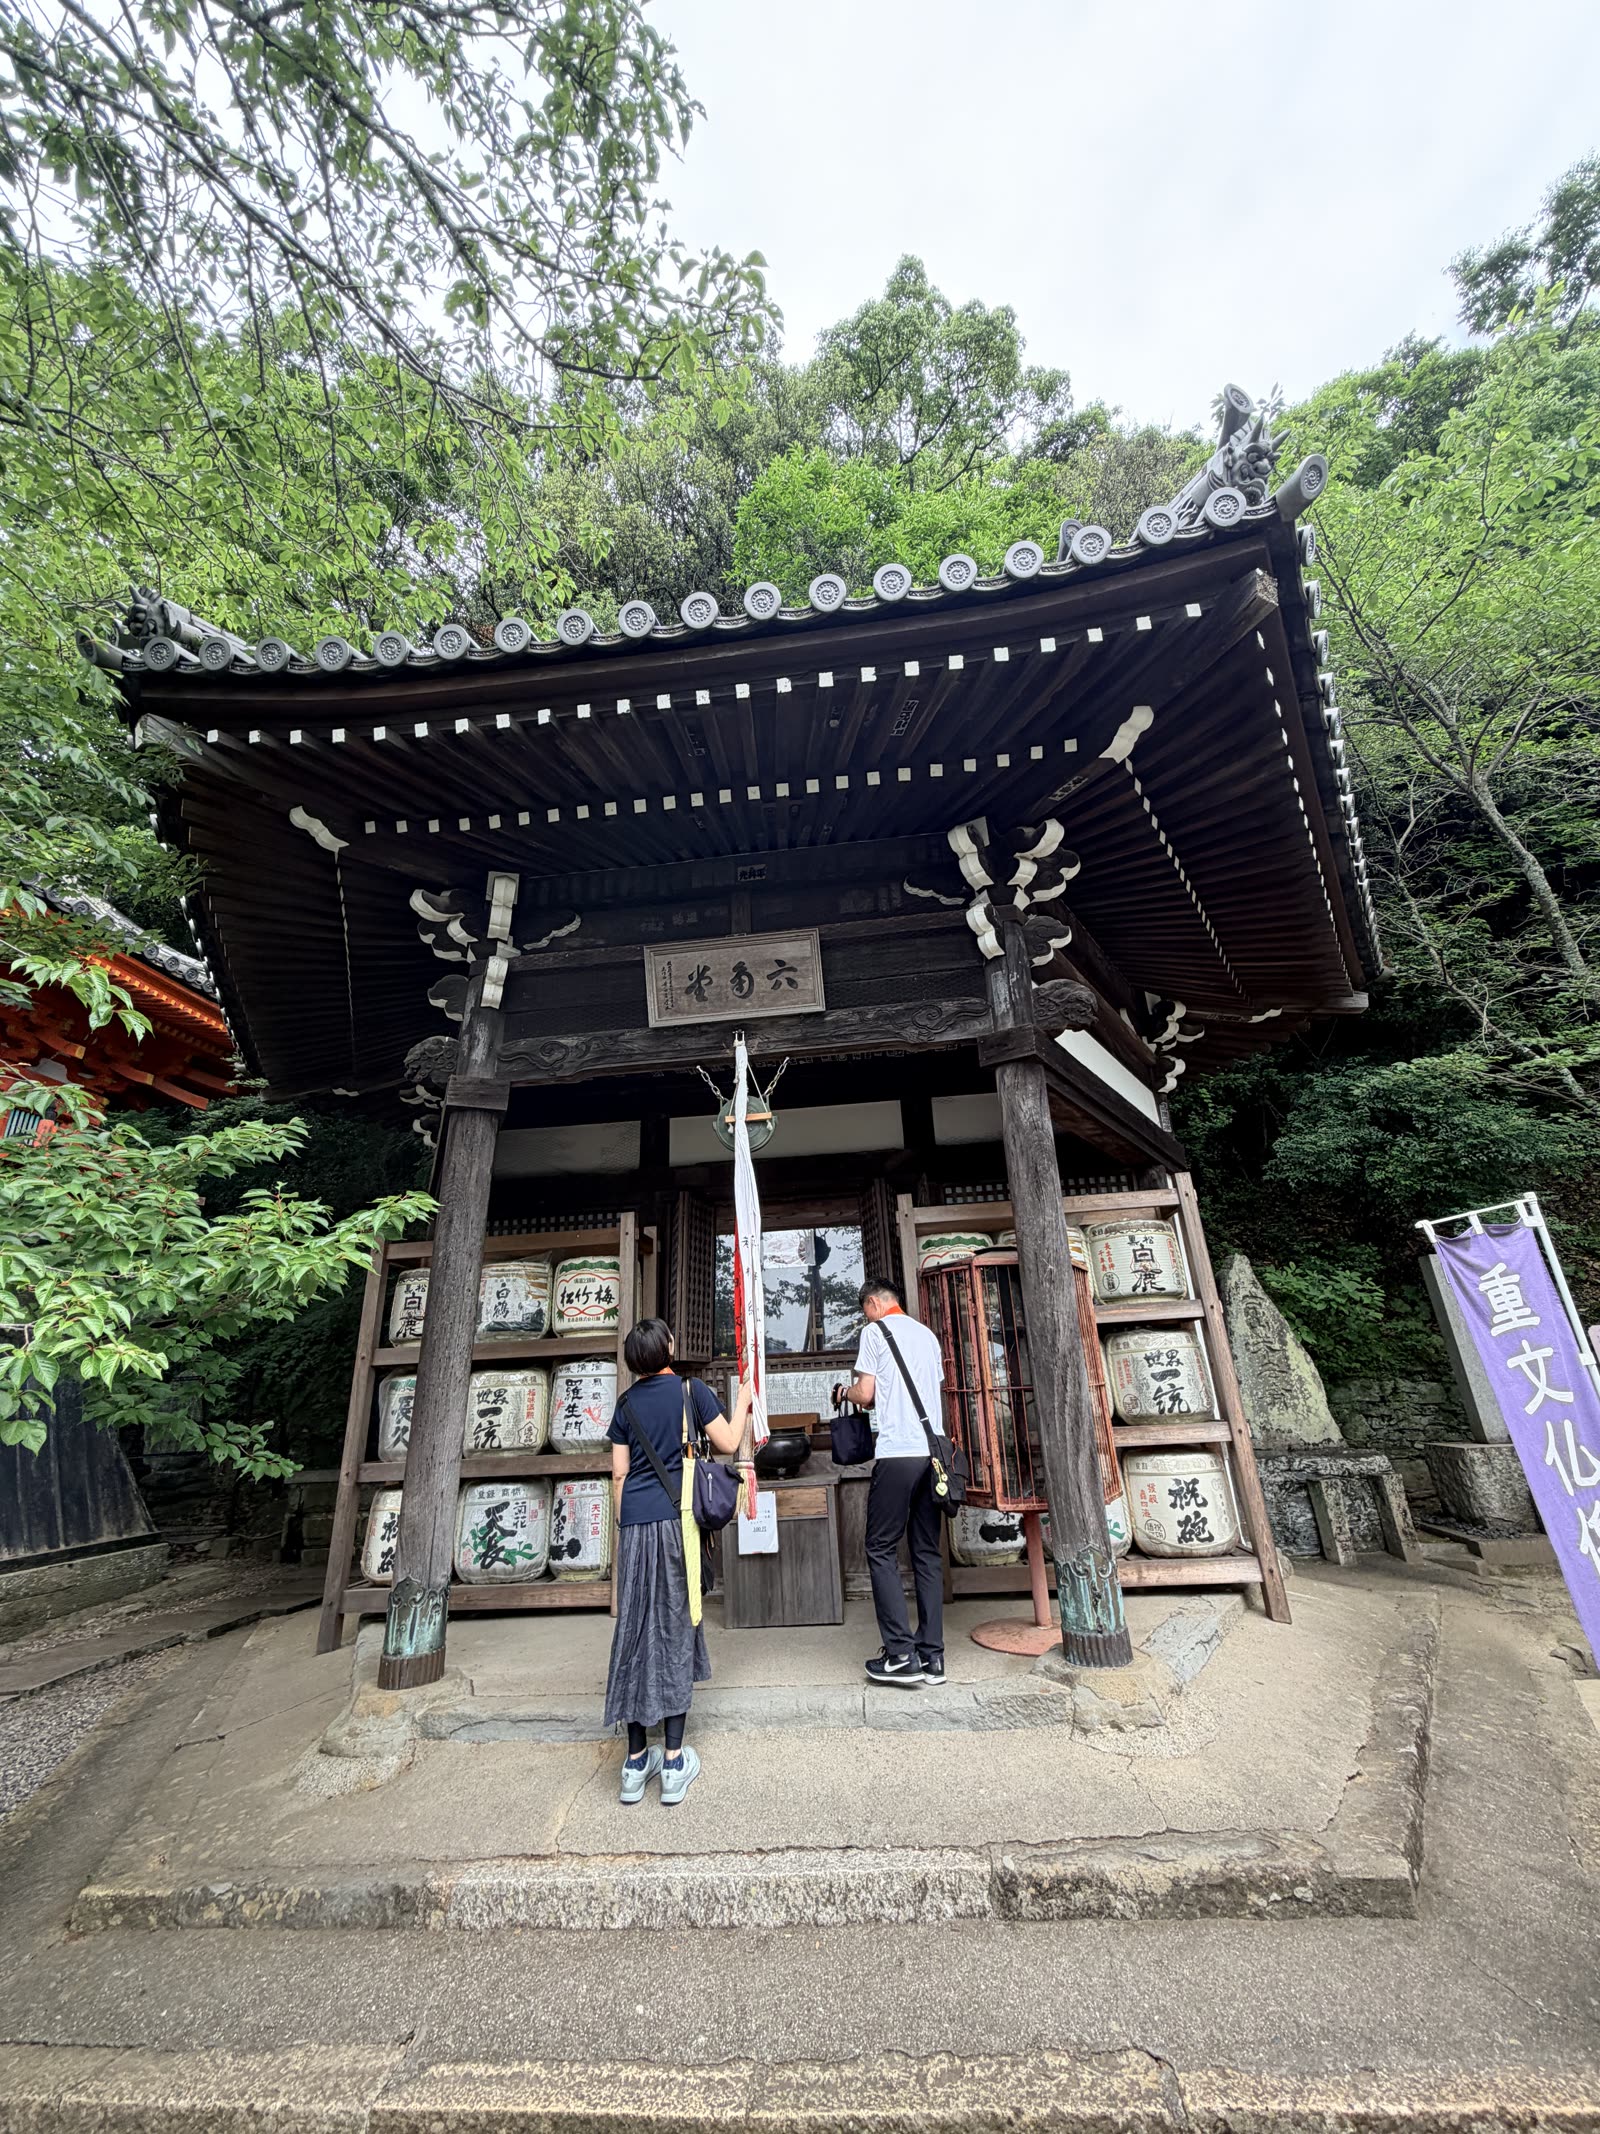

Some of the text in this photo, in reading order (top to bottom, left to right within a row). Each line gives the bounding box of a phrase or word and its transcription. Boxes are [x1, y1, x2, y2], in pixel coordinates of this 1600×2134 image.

[1131, 1243, 1166, 1292] 白鹿
[396, 1291, 424, 1338] 白鹿
[560, 1285, 615, 1307] 松竹梅
[562, 1379, 583, 1437] 羅生門
[591, 1504, 600, 1536] 天下一品
[1168, 1478, 1214, 1544] 祝砲
